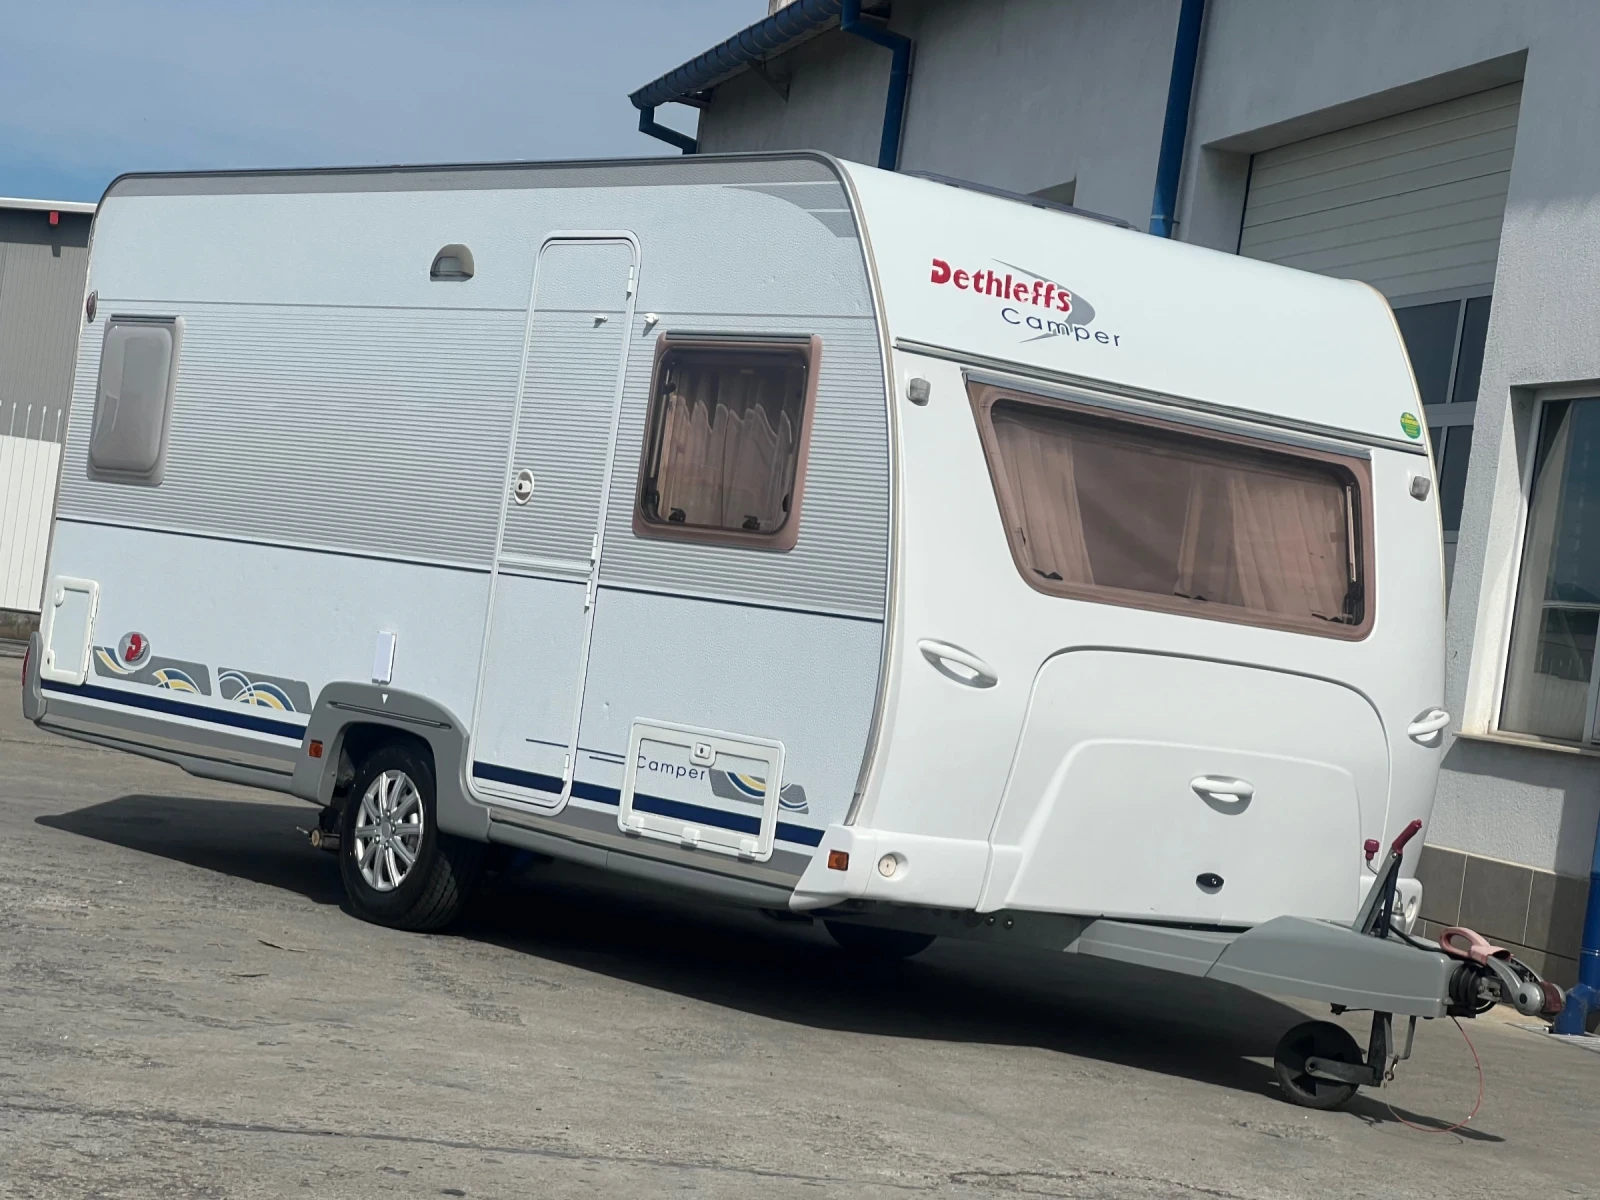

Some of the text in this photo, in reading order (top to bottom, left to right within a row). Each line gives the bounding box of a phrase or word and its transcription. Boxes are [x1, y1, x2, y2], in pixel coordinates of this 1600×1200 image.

[931, 258, 1072, 312] Dethleffs
[1001, 308, 1120, 346] Camper
[637, 755, 706, 781] Camper
